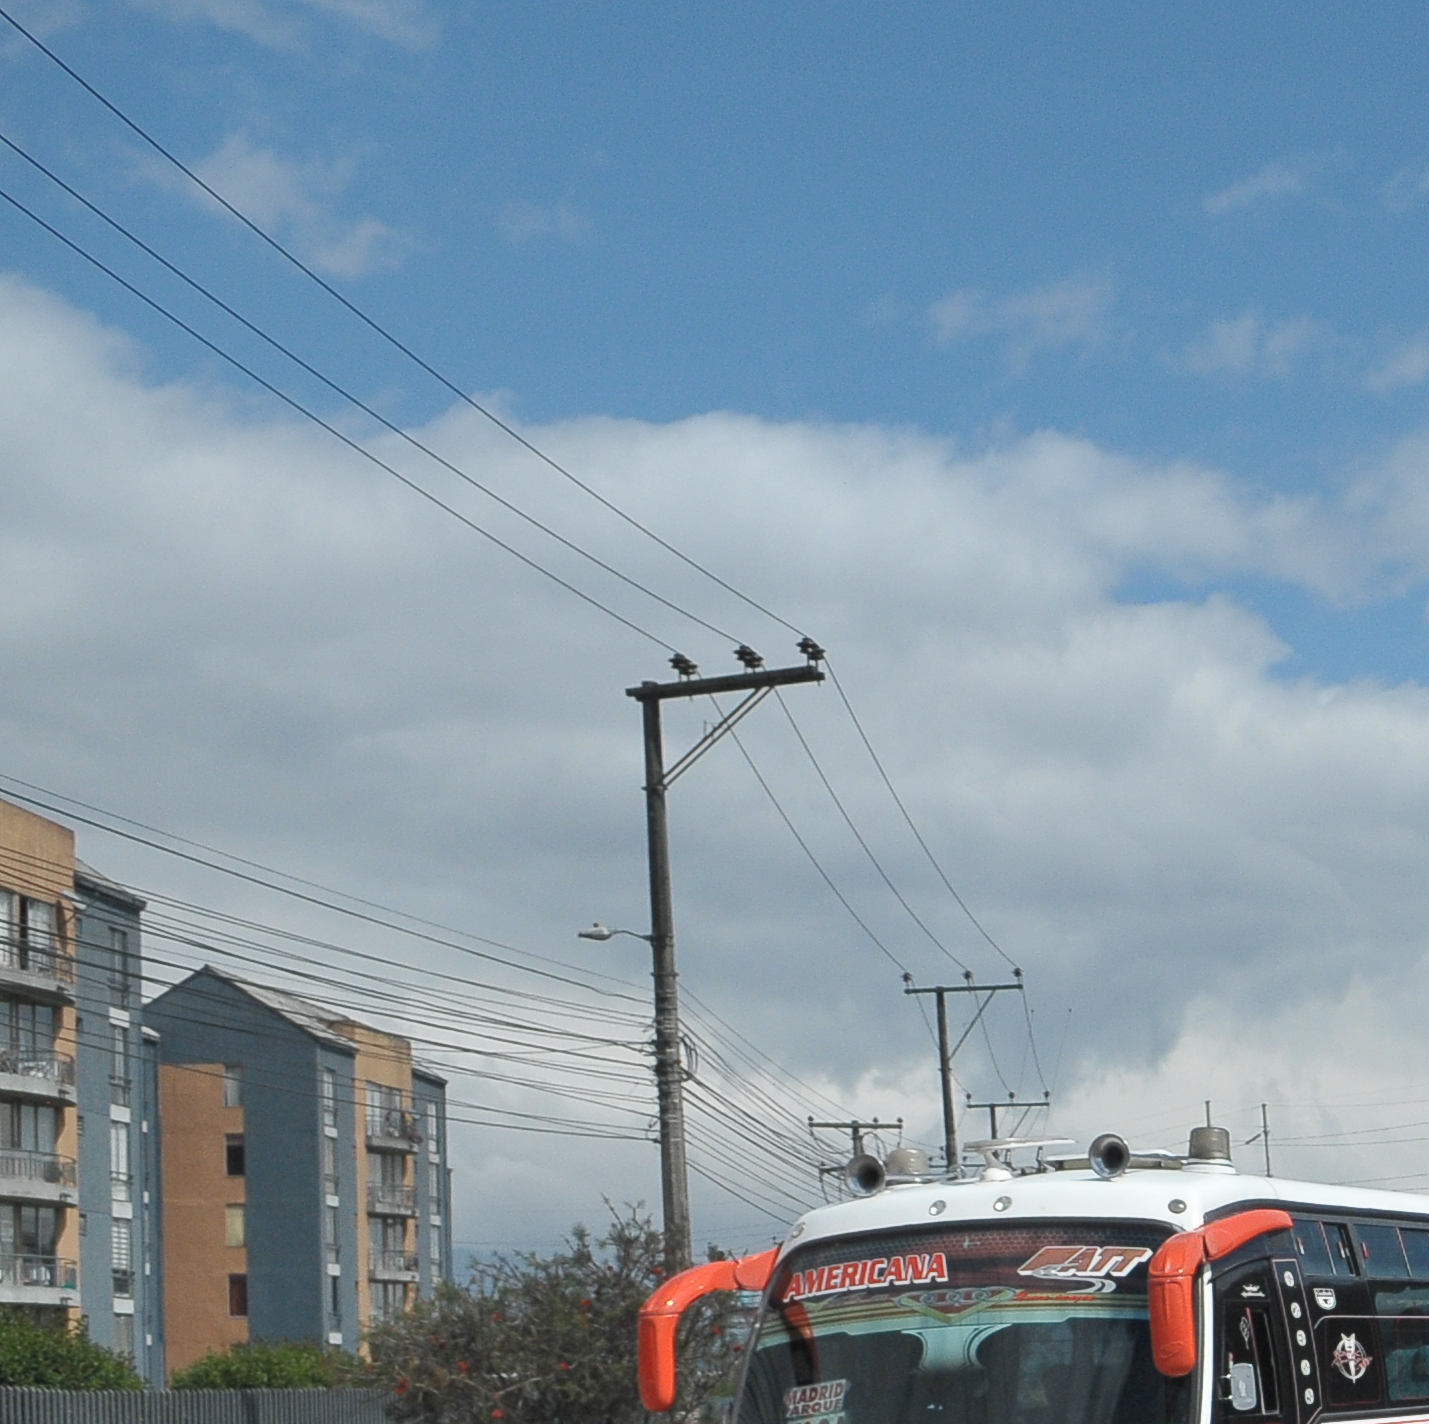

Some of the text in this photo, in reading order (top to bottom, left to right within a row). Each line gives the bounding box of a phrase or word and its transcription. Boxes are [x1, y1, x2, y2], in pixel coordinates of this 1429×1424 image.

[784, 1252, 949, 1303] AMERICANA
[785, 1382, 843, 1405] MADRID
[788, 1400, 841, 1417] ARQUE
